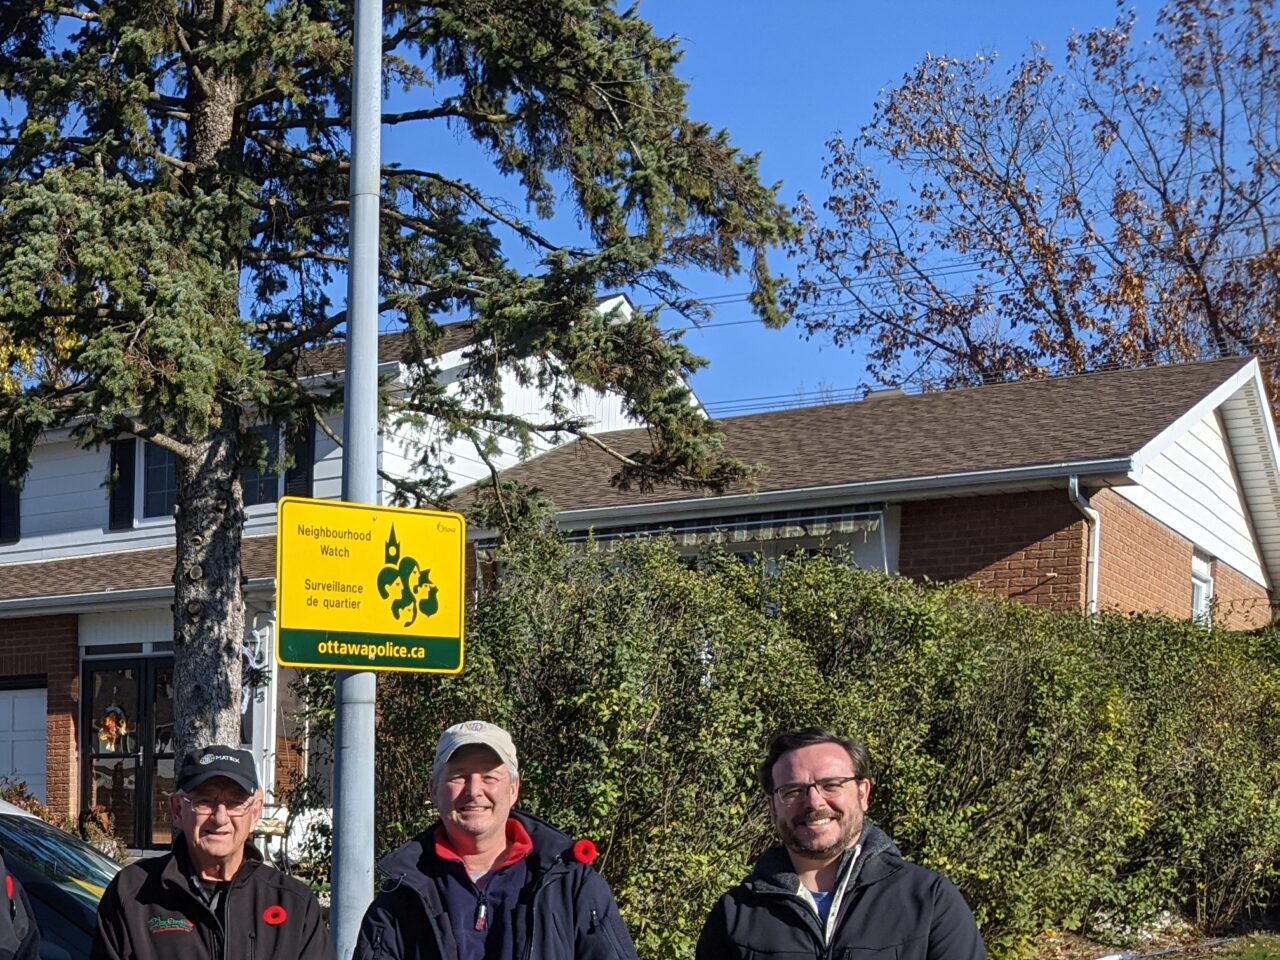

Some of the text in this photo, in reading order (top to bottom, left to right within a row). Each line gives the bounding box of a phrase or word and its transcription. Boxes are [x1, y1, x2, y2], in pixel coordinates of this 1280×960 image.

[297, 524, 372, 541] Neighbourhood
[319, 545, 350, 558] Watch
[304, 578, 364, 594] Surveillance
[306, 595, 361, 610] de quartier
[318, 639, 426, 660] ottawapolice.ca
[215, 755, 240, 764] MATRIX
